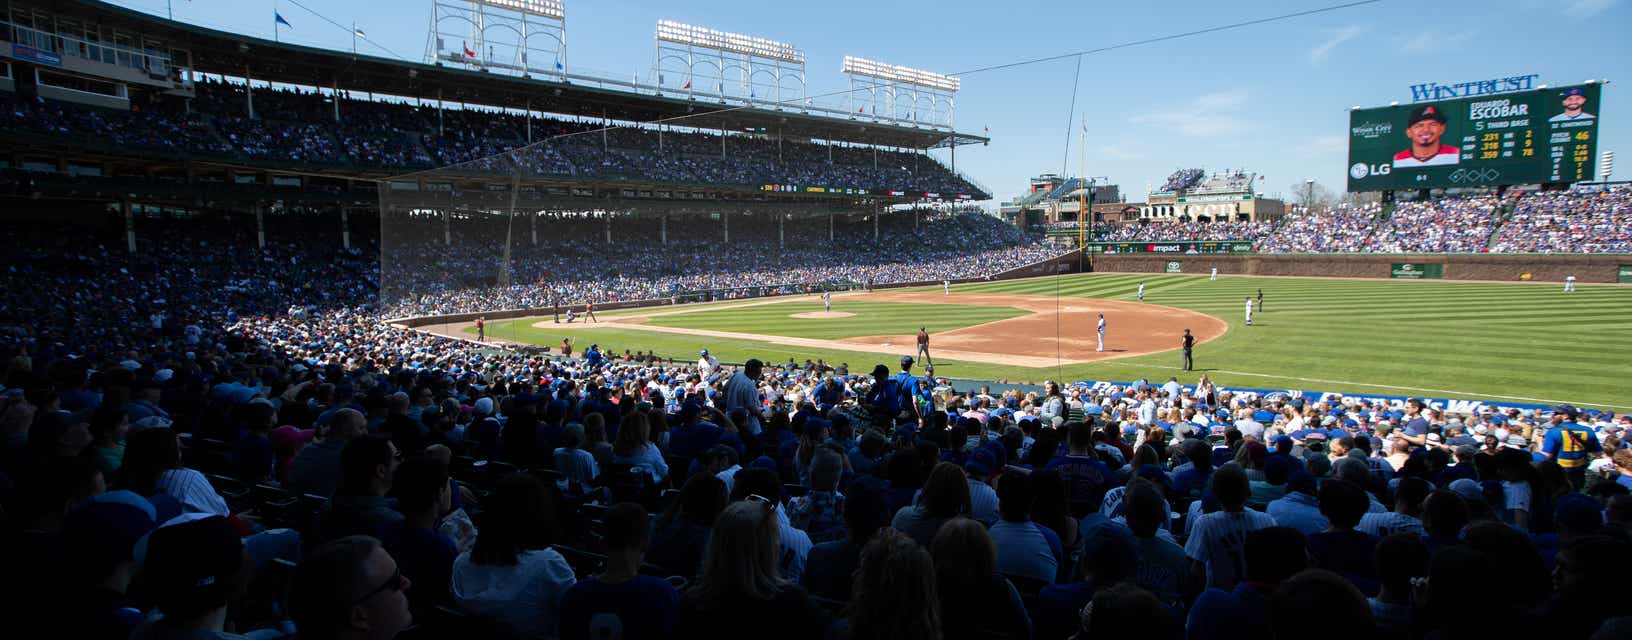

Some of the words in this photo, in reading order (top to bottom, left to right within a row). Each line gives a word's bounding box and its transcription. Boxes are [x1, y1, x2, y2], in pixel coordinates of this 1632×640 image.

[1409, 74, 1539, 101] WINTRUST
[1470, 104, 1528, 120] ESCOBAR
[1576, 131, 1589, 140] 46
[1370, 163, 1391, 176] LG
[1153, 244, 1180, 253] impact
